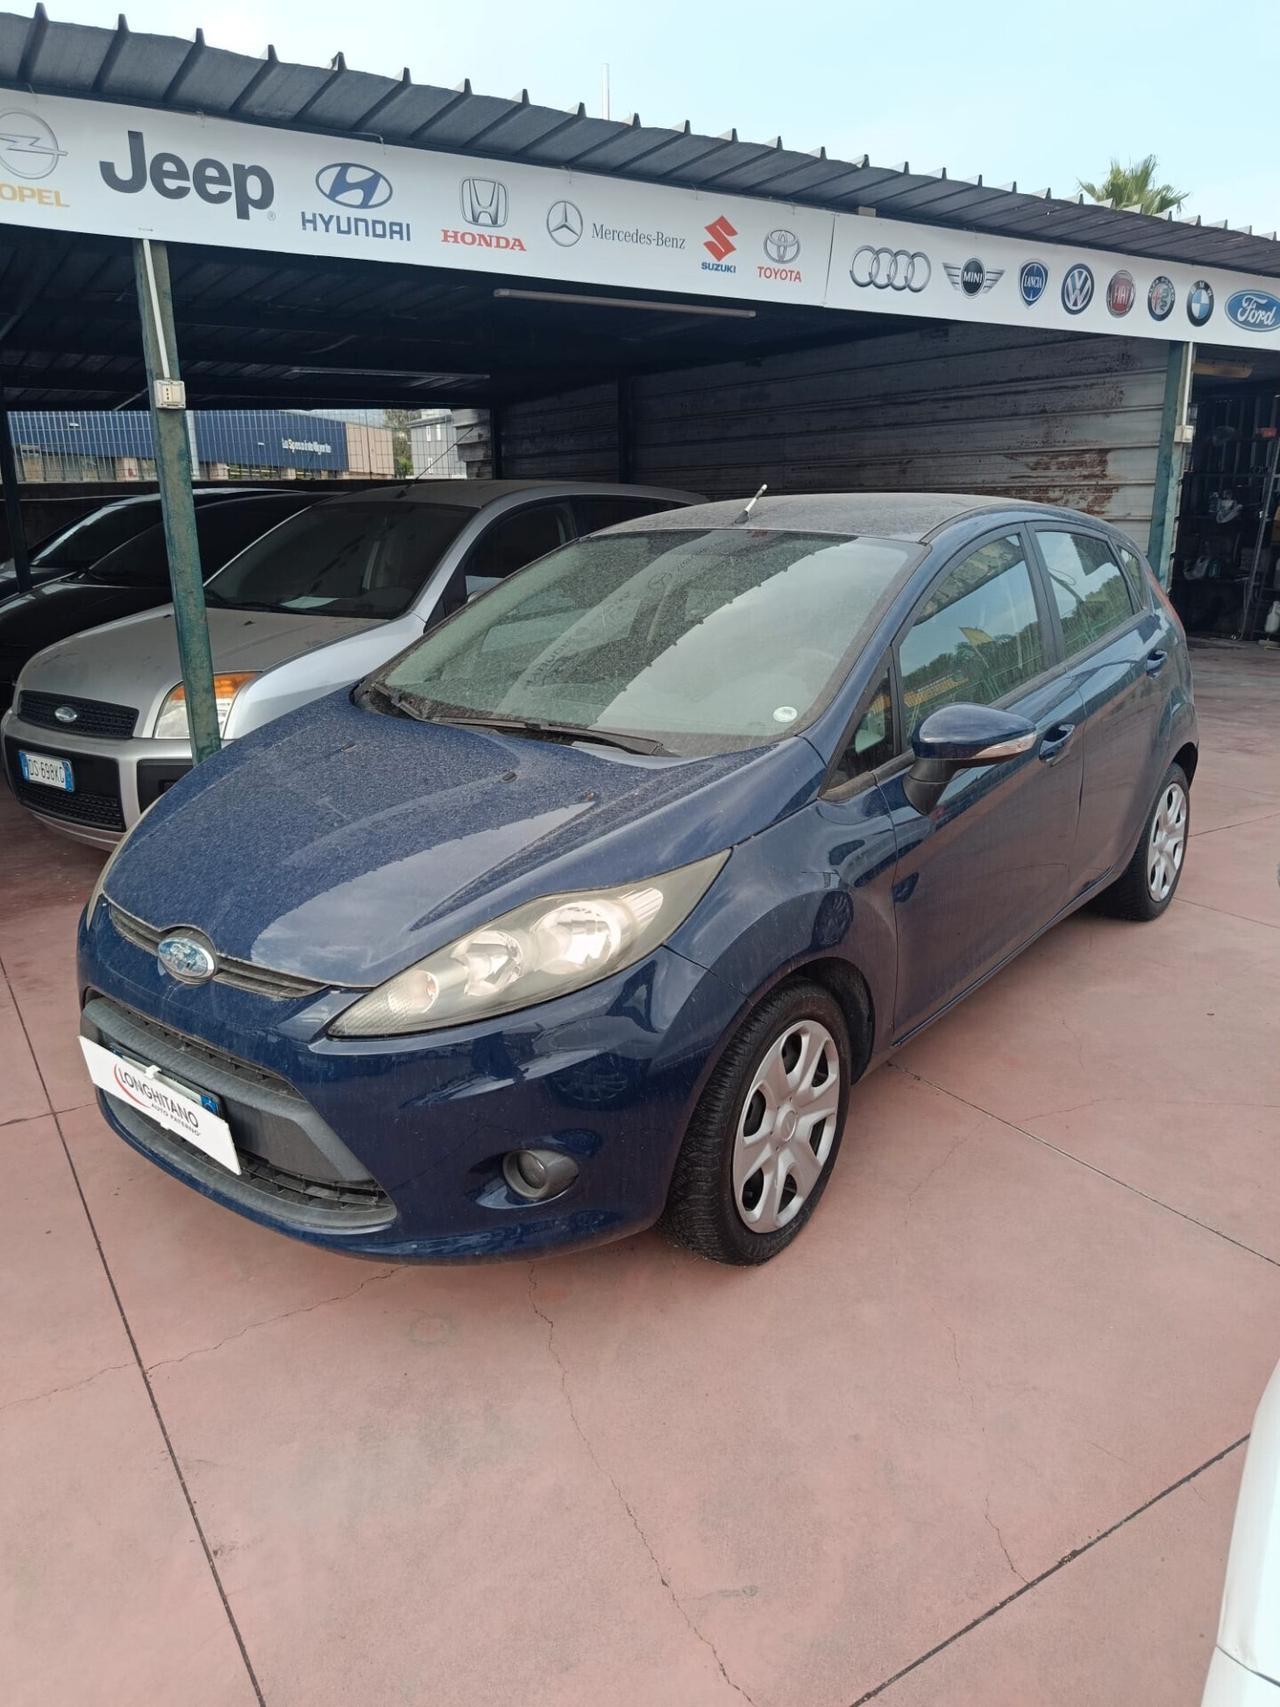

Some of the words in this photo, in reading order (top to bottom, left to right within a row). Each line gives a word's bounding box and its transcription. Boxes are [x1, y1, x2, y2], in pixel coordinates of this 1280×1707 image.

[99, 130, 275, 221] Jeep
[0, 183, 70, 208] OPEL
[300, 211, 412, 242] HYUNDAI
[592, 223, 686, 250] Mercedes-Benz
[441, 229, 527, 251] HONDA
[701, 262, 737, 273] SUZUKI
[757, 266, 803, 282] TOYOTA
[963, 271, 983, 283] MINI
[1236, 295, 1277, 326] Ford
[118, 1067, 199, 1128] LONGHITANO
